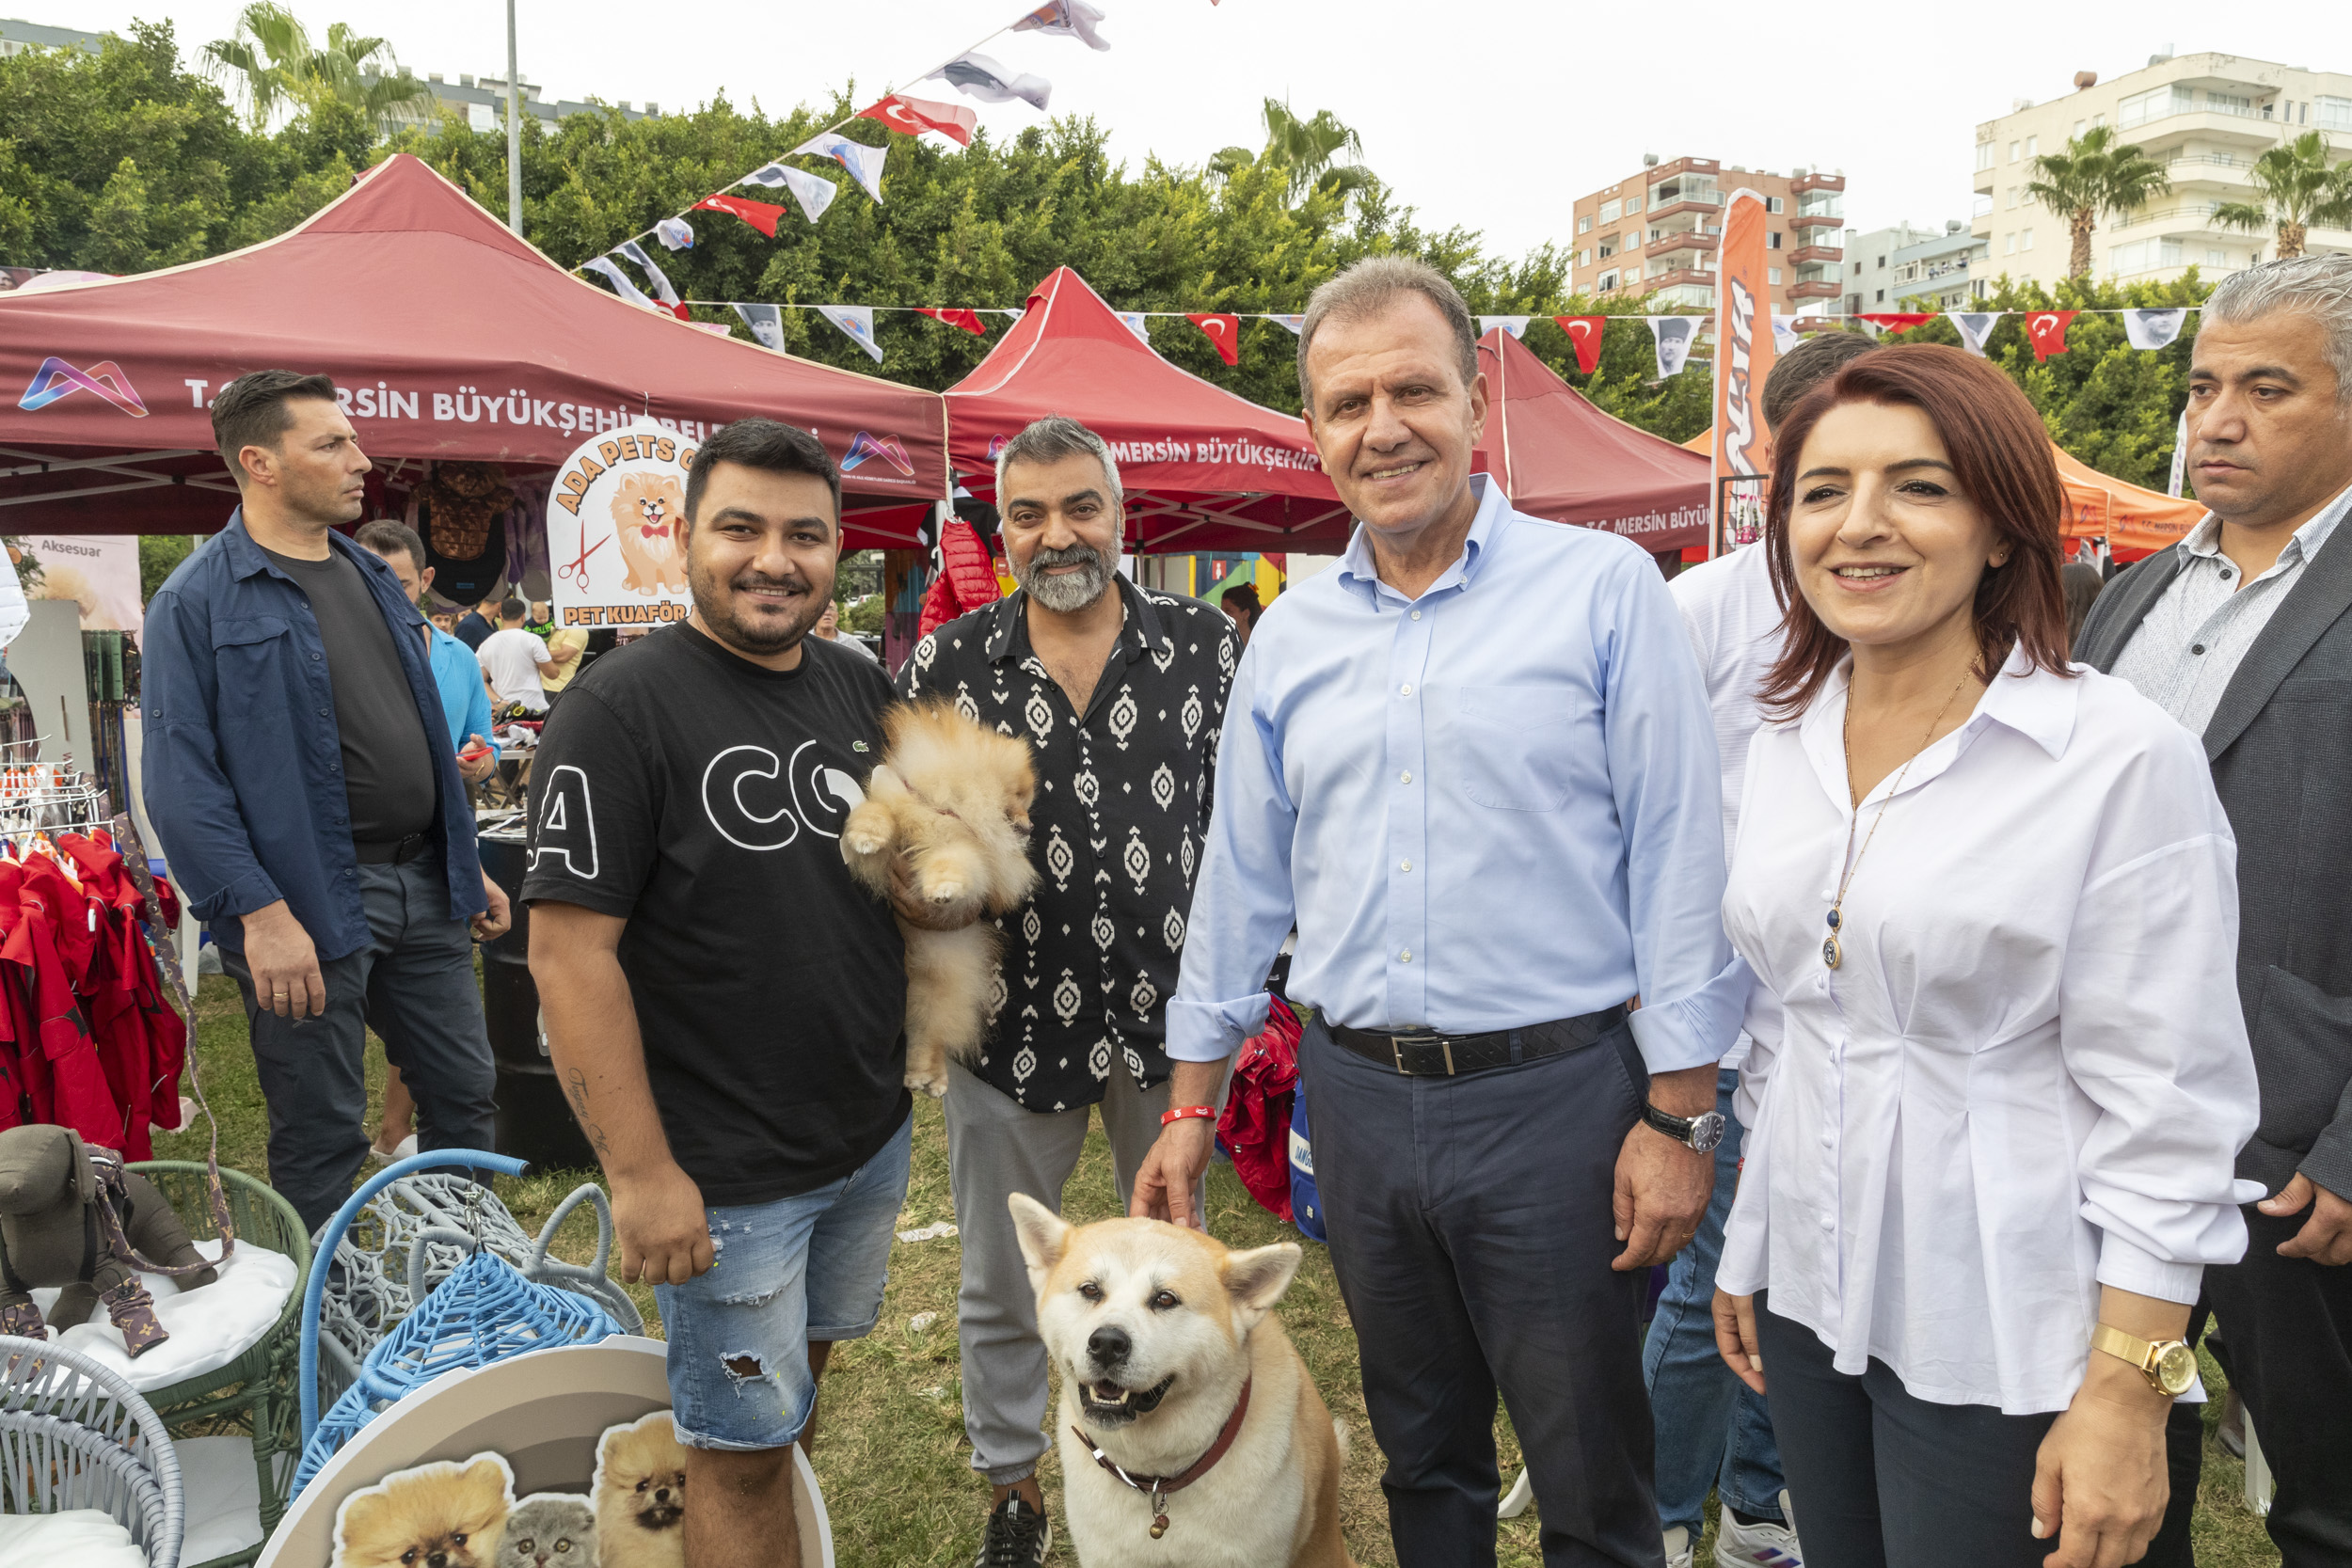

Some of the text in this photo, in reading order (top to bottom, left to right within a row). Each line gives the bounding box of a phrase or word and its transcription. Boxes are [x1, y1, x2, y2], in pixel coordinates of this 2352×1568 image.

[336, 381, 420, 420] RSİN
[433, 386, 646, 438] BÜYÜKŞEHİ
[1110, 436, 1320, 472] MERSİN BÜYÜKŞEHİR
[556, 455, 607, 516] ADA
[597, 434, 676, 468] PETS
[1614, 510, 1666, 534] MERSİN
[41, 539, 103, 557] Aksesuar
[564, 600, 687, 626] PET KUAFÖR
